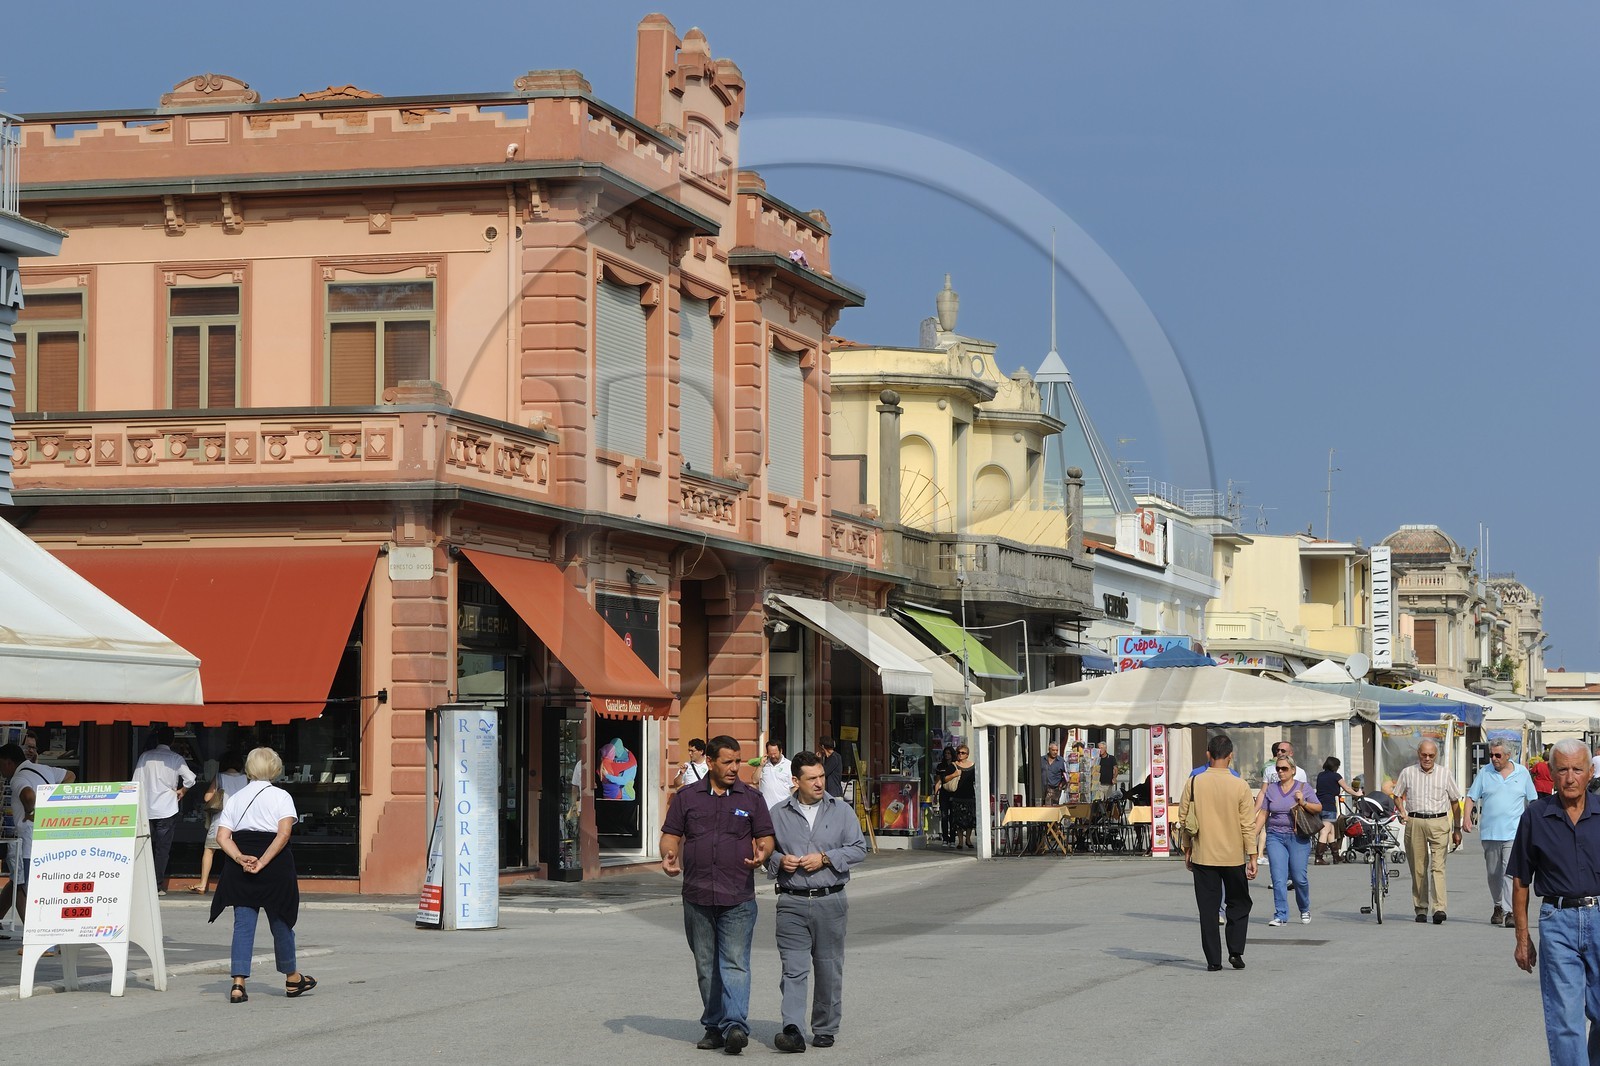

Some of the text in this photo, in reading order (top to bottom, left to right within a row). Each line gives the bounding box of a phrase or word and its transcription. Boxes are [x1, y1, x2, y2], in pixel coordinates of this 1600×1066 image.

[1372, 558, 1390, 656] SOMMARIVA
[1123, 637, 1158, 655] Crêpes
[1217, 653, 1235, 666] Sa
[1235, 652, 1263, 667] Playa
[628, 699, 641, 713] Rossi
[74, 785, 112, 794] FUJIFILM
[40, 815, 130, 828] IMMEDIATE
[457, 718, 471, 918] RISTORANTE
[33, 846, 131, 867] Sviluppo e Stampa:
[41, 870, 120, 880] Rullino da 24 Pose
[66, 883, 92, 892] € 6,80
[39, 895, 118, 905] Rullino da 36 Pose
[64, 908, 90, 917] € 9,20
[95, 925, 118, 938] FDi
